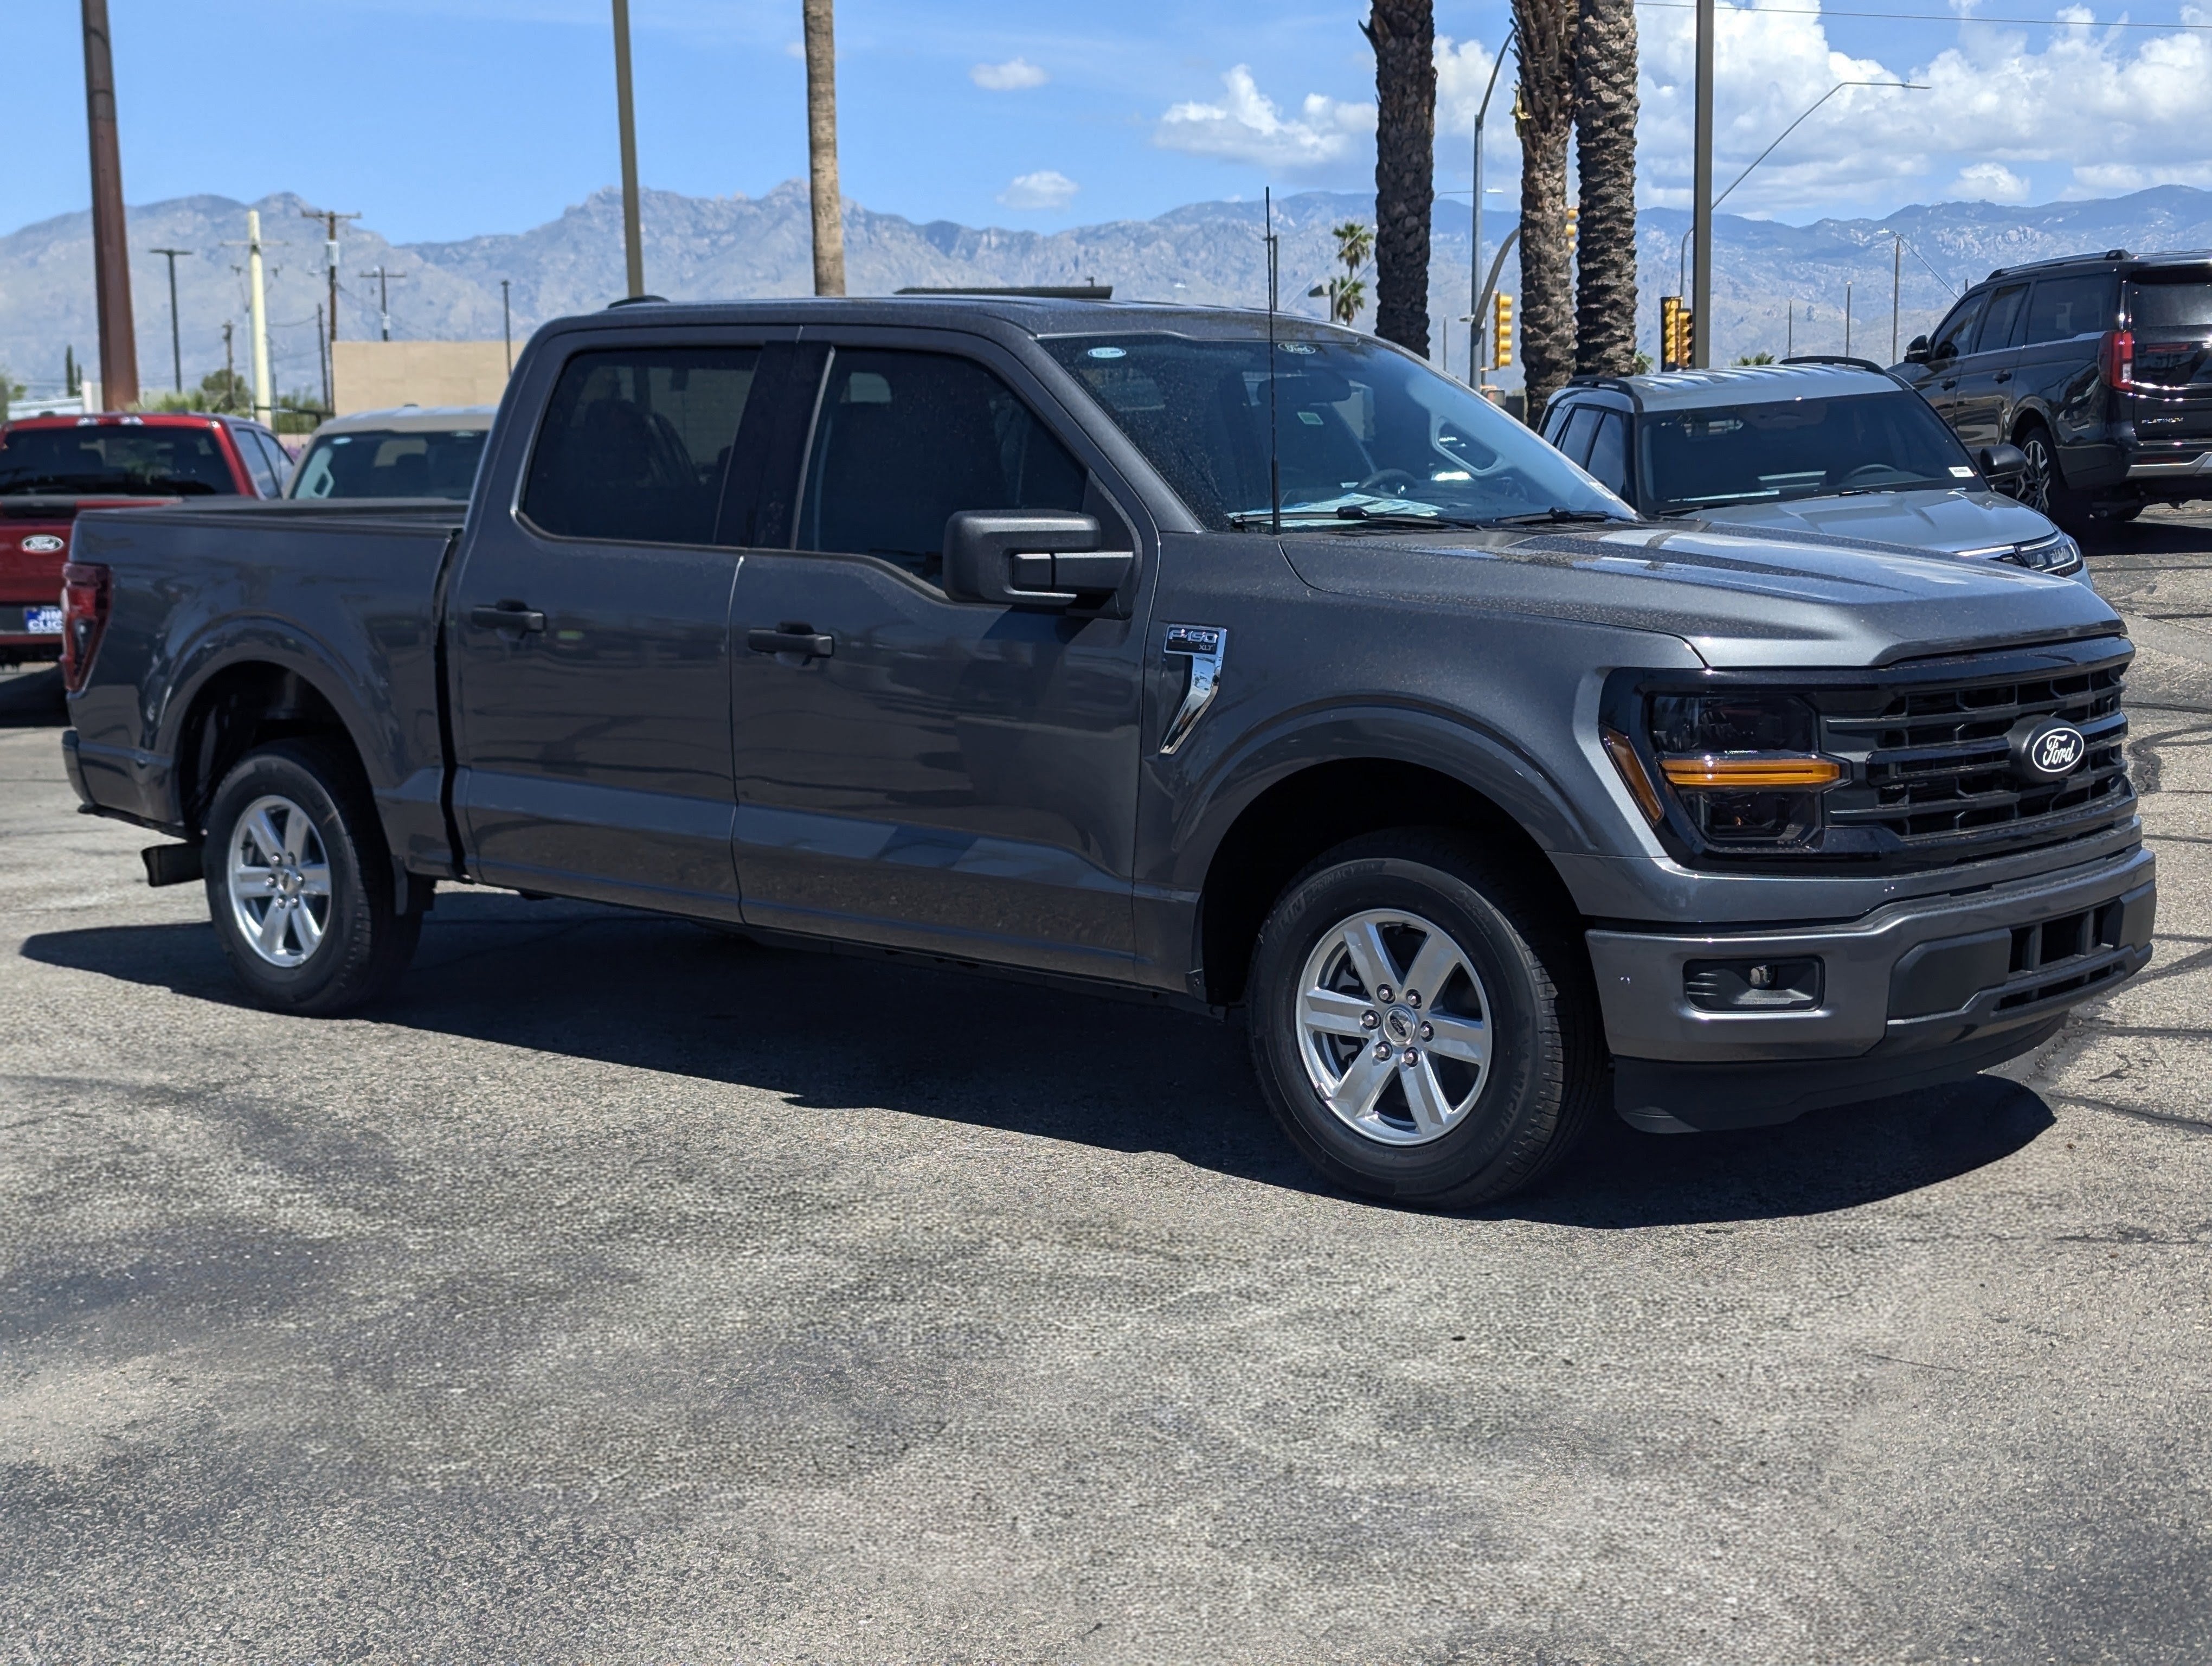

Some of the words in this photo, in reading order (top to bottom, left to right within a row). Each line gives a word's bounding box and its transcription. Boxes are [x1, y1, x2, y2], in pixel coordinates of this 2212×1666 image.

[37, 610, 63, 620] JIM
[28, 619, 63, 630] CLIC
[1168, 629, 1218, 644] F-150
[2042, 734, 2075, 766] Ford
[1310, 865, 1355, 894] PRIMACY
[1391, 1018, 1405, 1033] Ford
